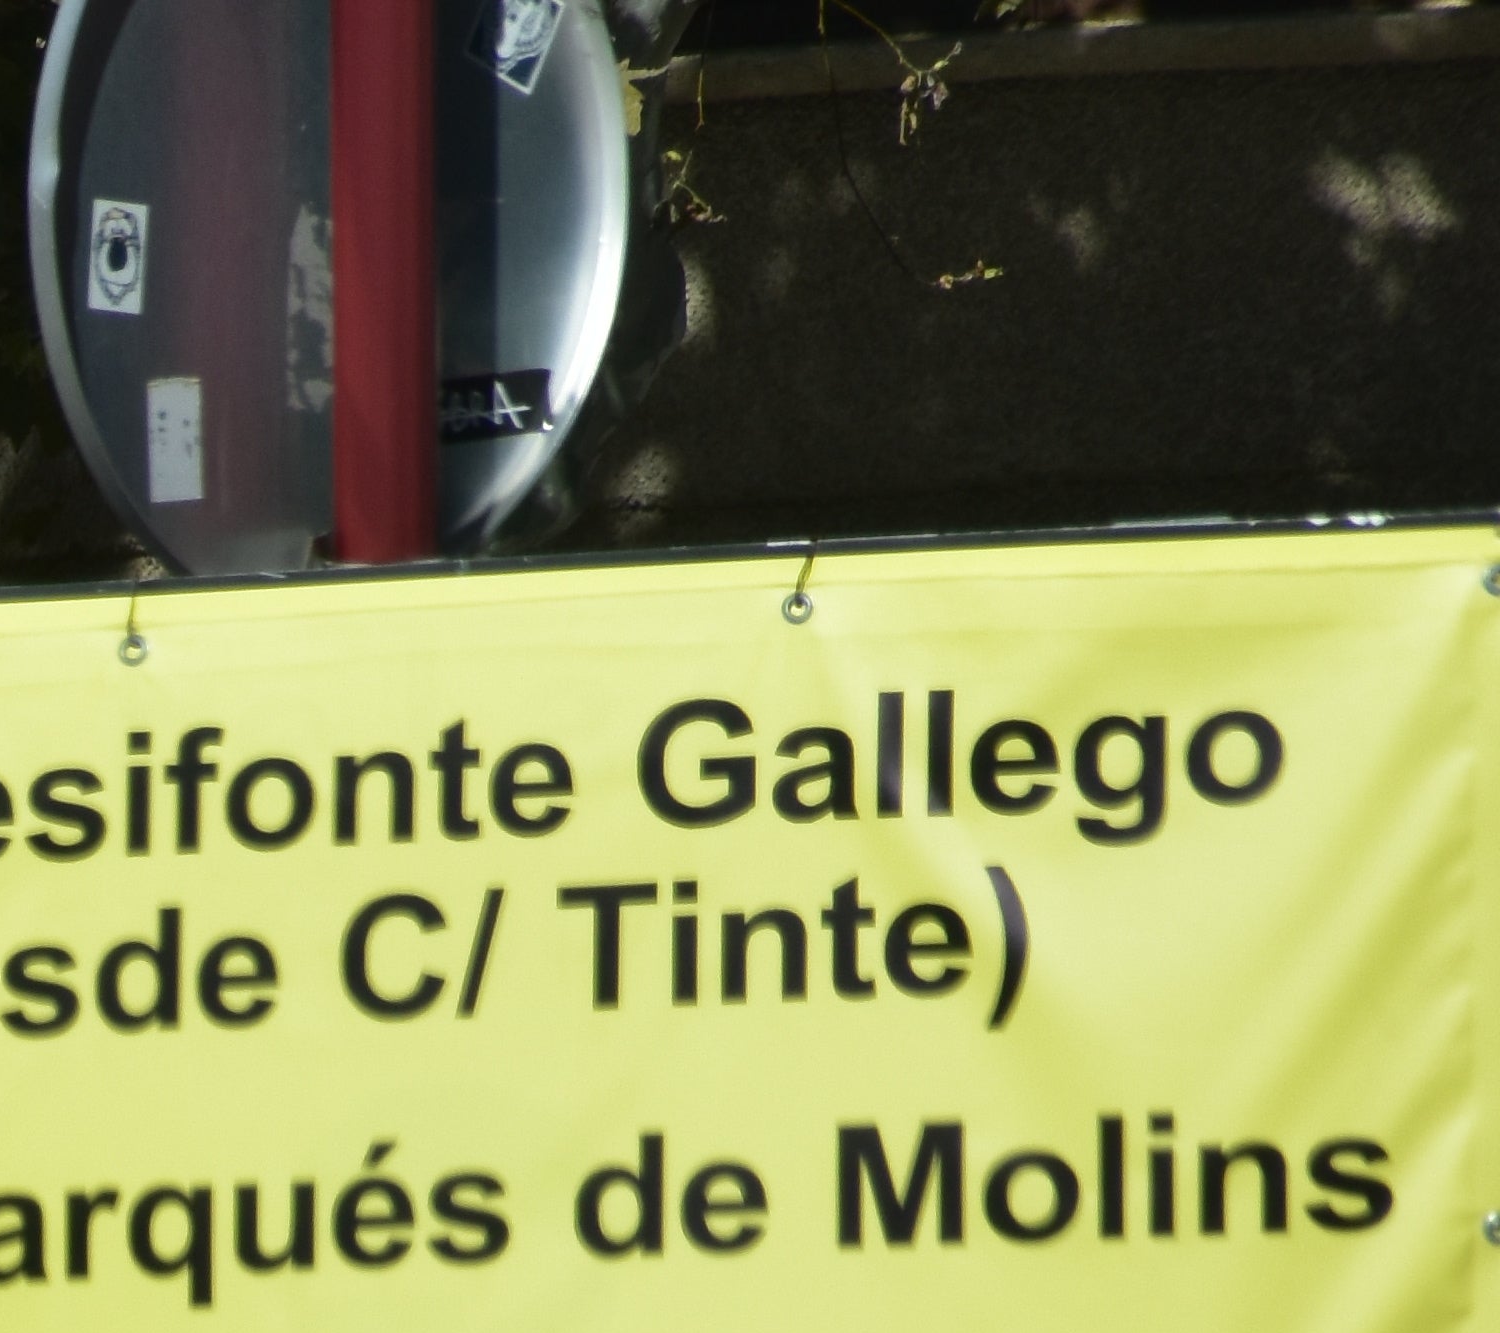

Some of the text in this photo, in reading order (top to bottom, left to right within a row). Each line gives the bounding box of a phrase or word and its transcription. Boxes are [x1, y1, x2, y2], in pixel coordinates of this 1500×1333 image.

[637, 688, 1285, 846] Gallego
[341, 887, 506, 1020] C/
[557, 866, 1029, 1029] Tinte)
[574, 1133, 769, 1259] de
[836, 1113, 1395, 1247] Molins
